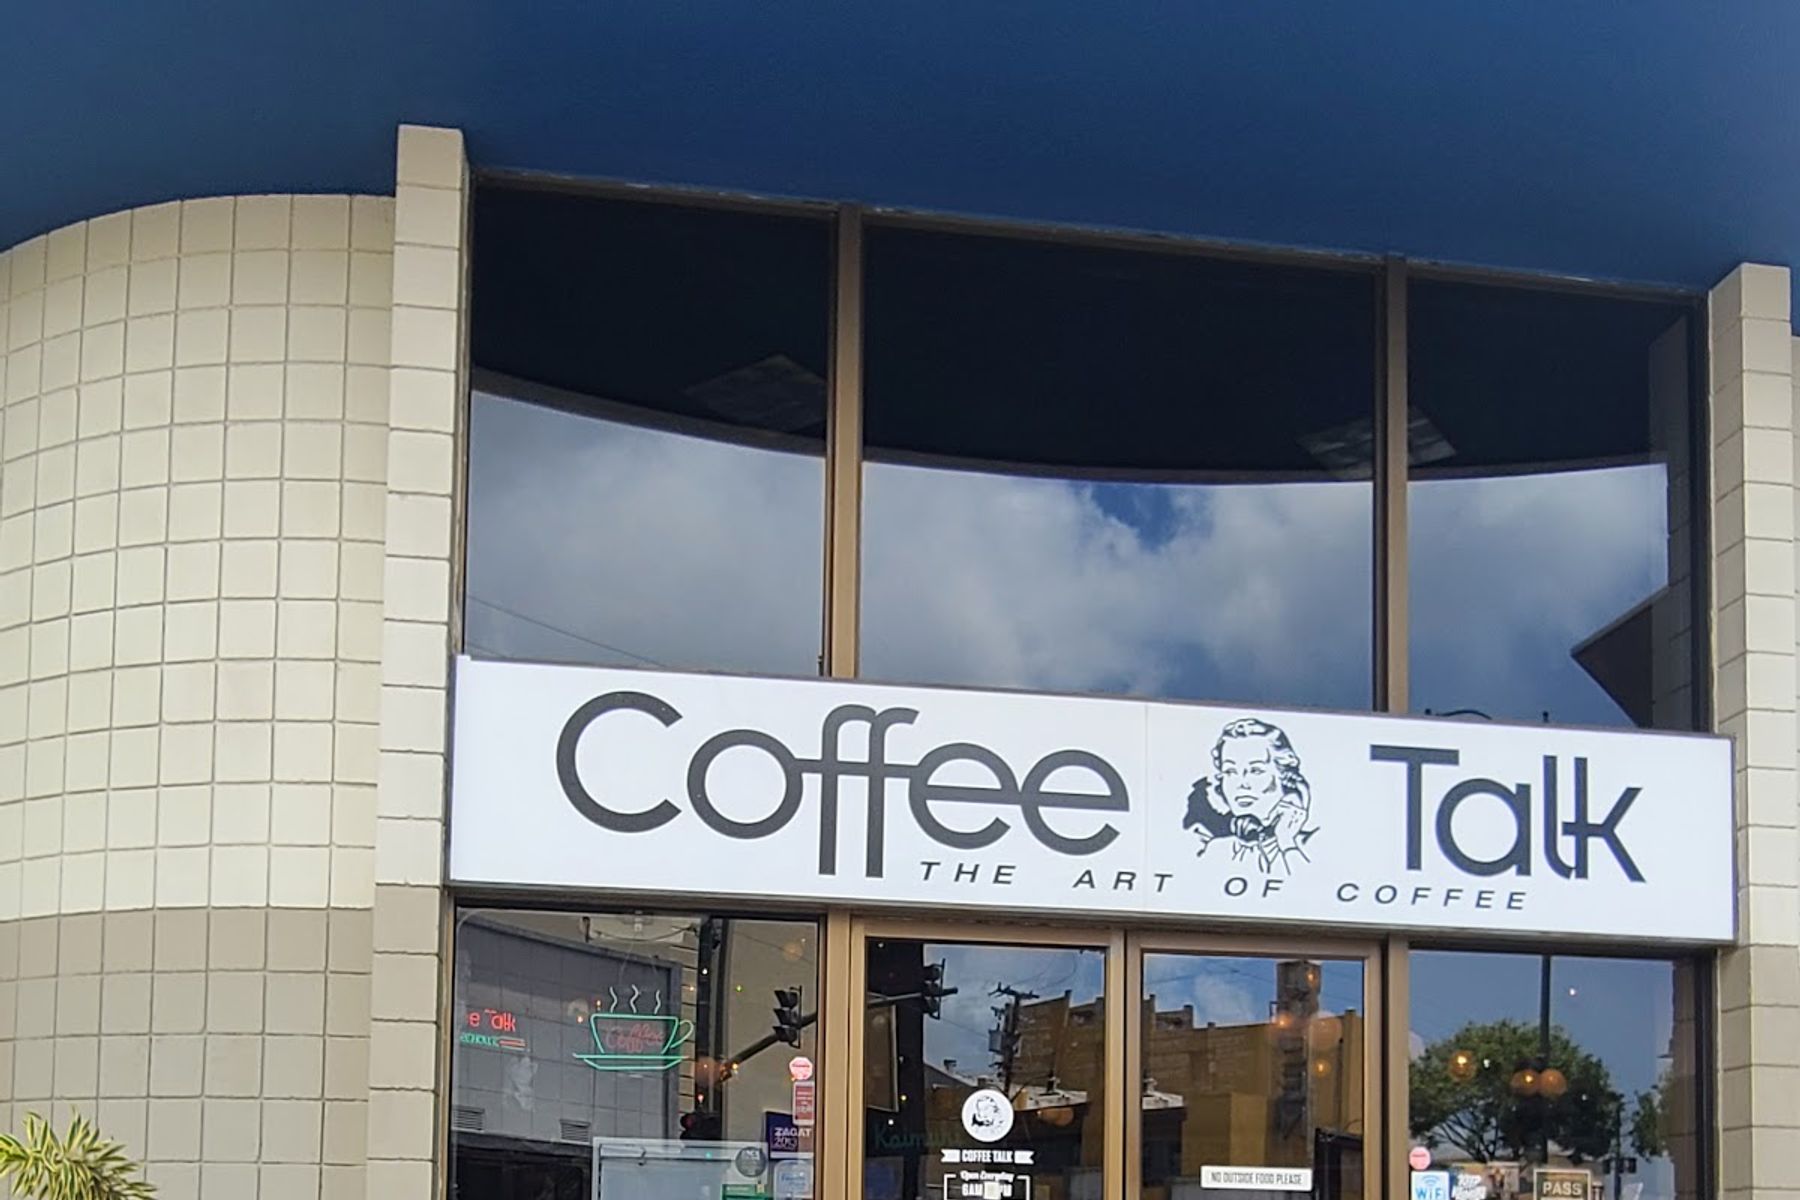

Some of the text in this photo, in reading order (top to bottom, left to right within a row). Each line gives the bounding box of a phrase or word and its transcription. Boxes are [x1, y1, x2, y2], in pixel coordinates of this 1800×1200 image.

[556, 690, 1647, 883] Coffee Talk
[918, 860, 1528, 910] THE ART OF COFFEE
[774, 1127, 812, 1137] ZAGAT
[962, 1149, 992, 1163] COFFEE
[1211, 1171, 1304, 1185] NO OUTSIDE FOOD PLEASE
[1543, 1181, 1582, 1196] PASS
